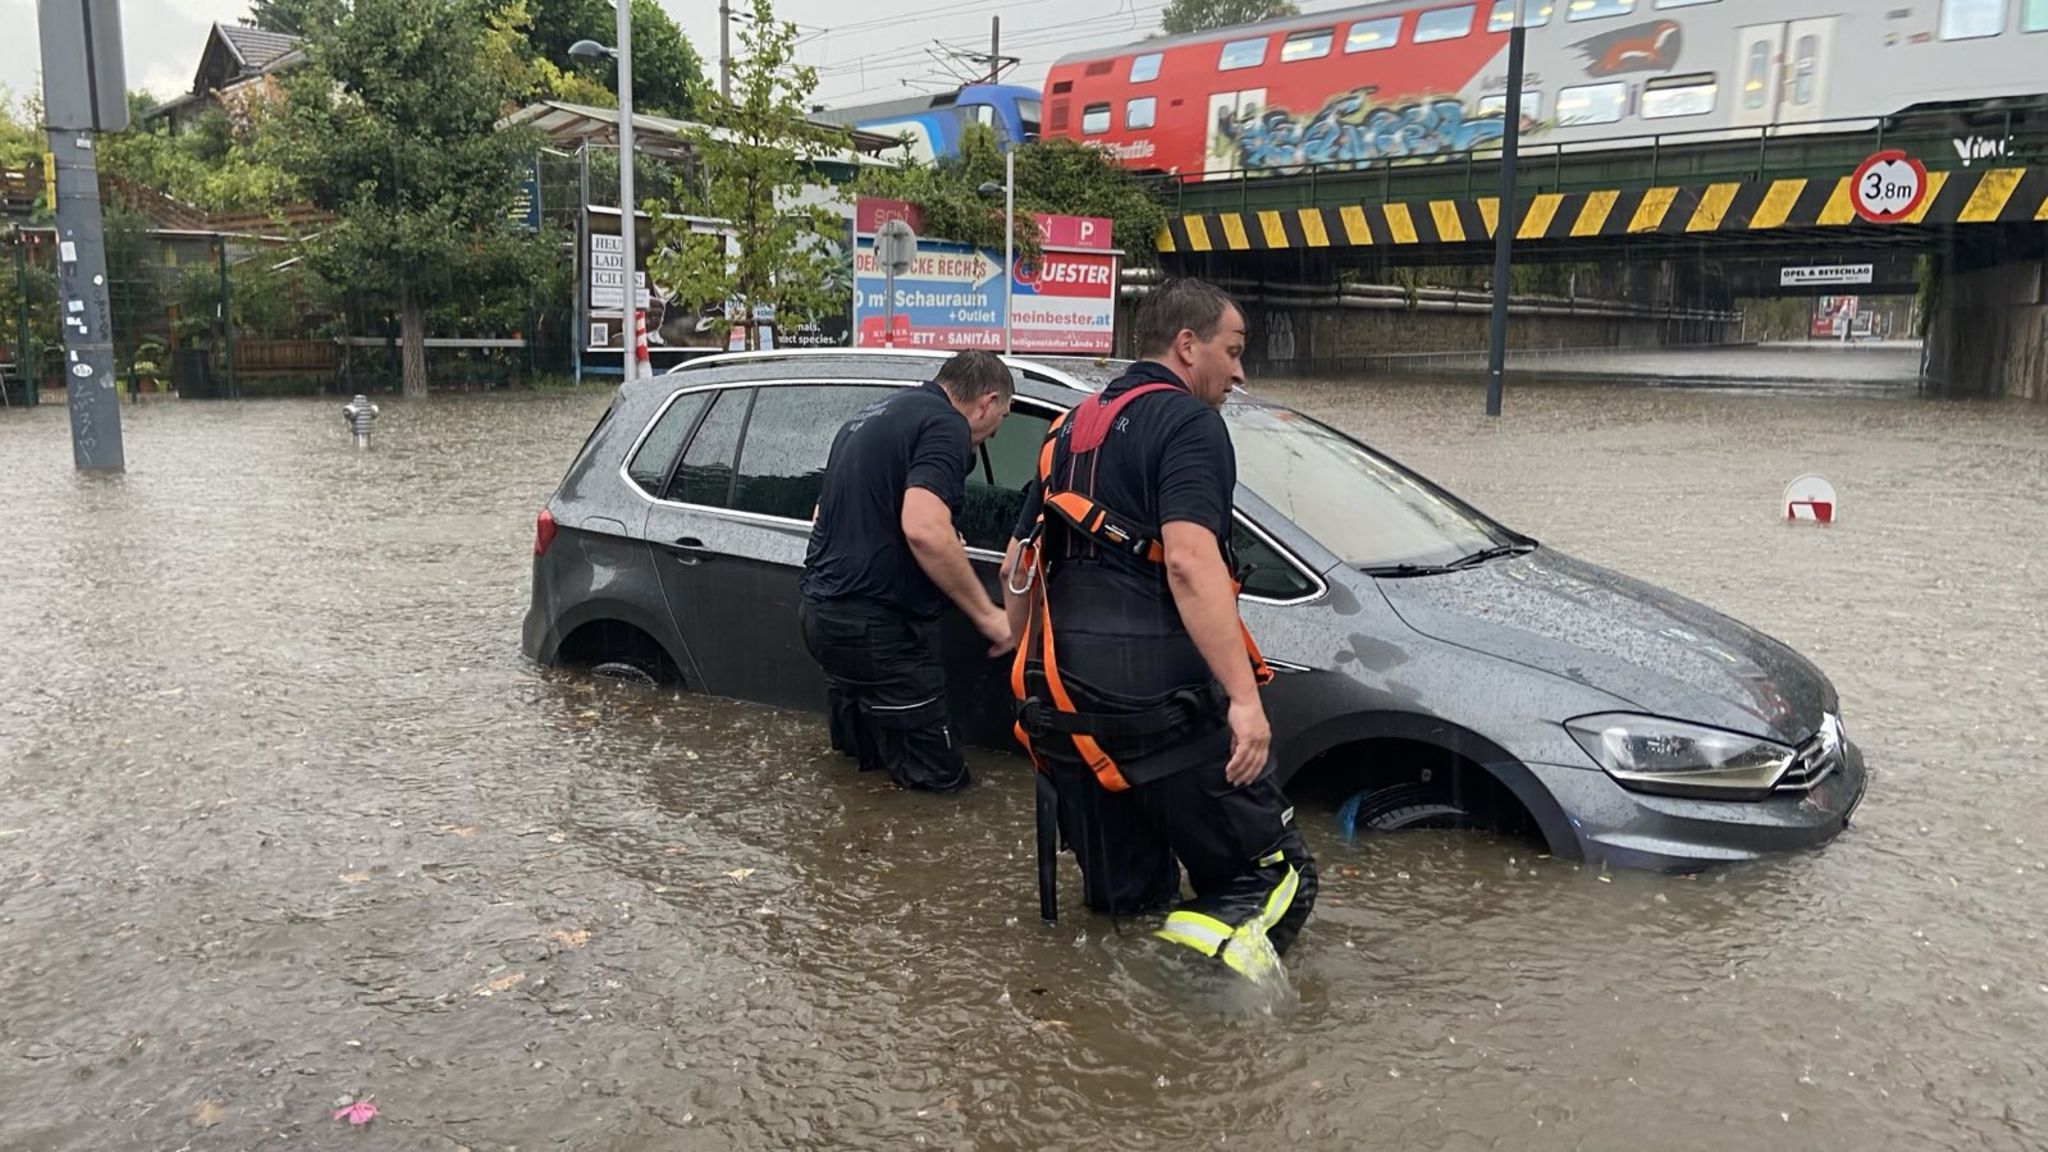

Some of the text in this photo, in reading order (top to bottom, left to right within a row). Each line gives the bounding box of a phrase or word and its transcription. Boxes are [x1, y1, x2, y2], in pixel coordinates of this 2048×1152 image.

[1081, 221, 1094, 241] P
[595, 237, 623, 250] HEU
[938, 261, 987, 278] RECHTS
[1783, 270, 1806, 278] OPEL
[895, 290, 988, 308] Schauraum
[798, 333, 837, 346] species.
[947, 331, 1001, 345] SANITÄR
